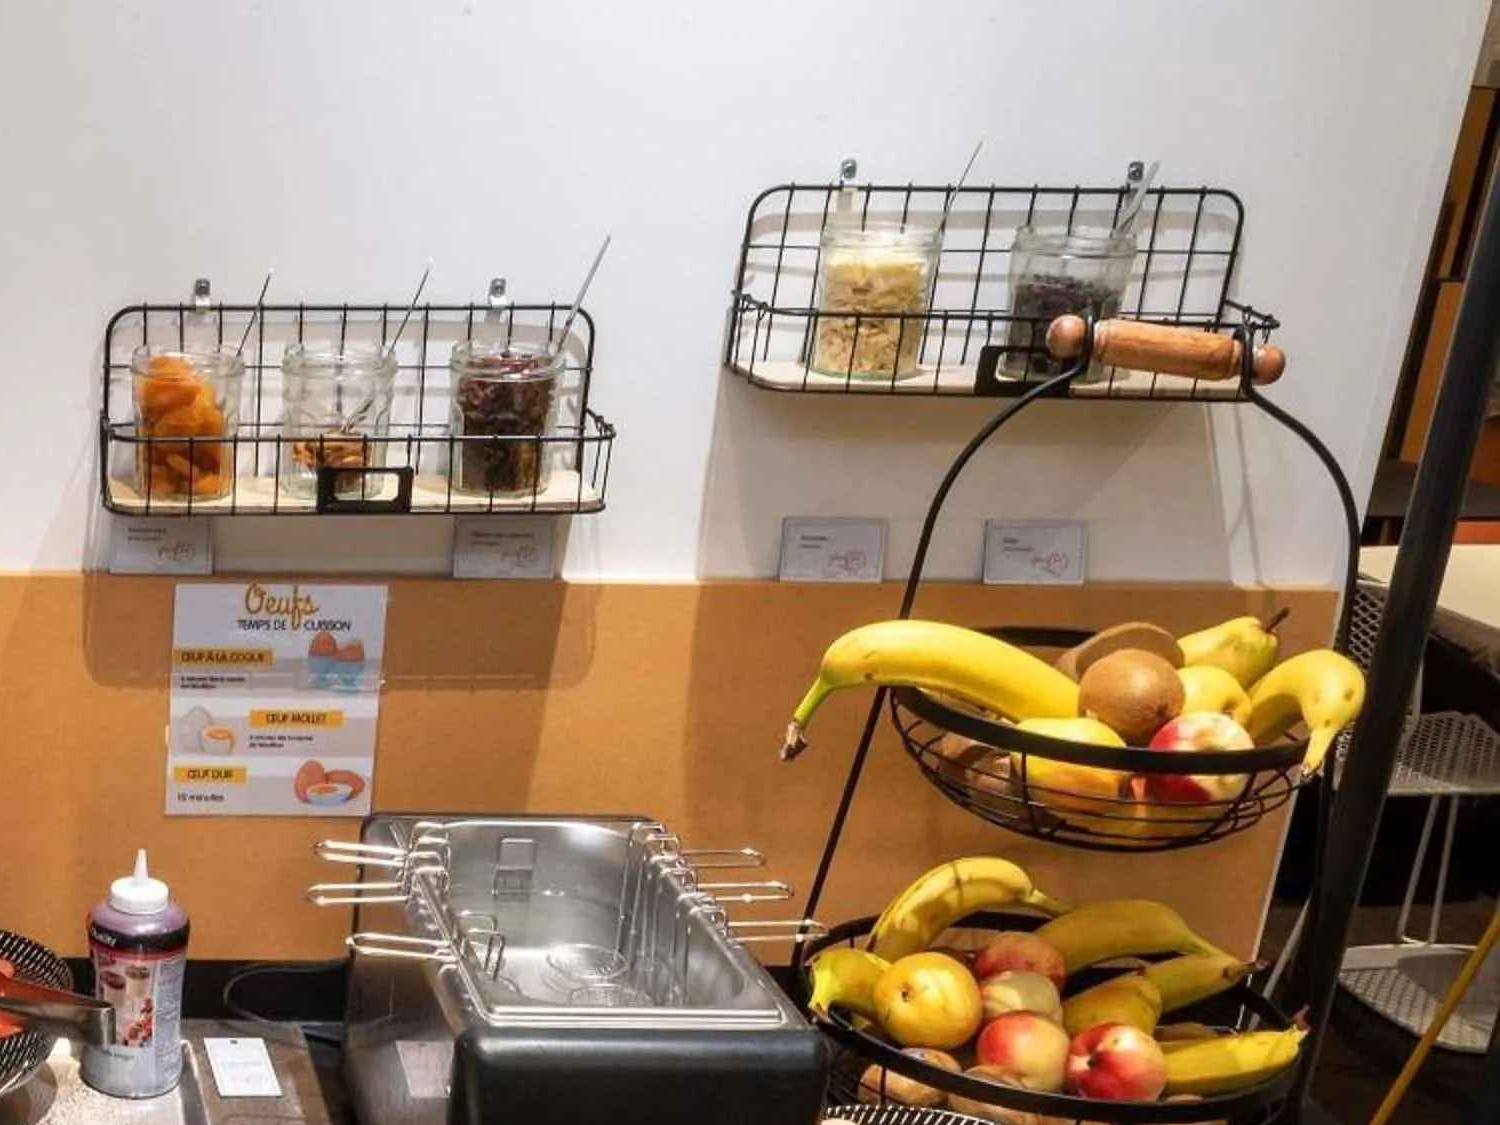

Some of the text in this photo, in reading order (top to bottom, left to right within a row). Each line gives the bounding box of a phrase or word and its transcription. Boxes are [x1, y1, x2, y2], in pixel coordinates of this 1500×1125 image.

[238, 619, 351, 632] TEMPS DE CUISSON
